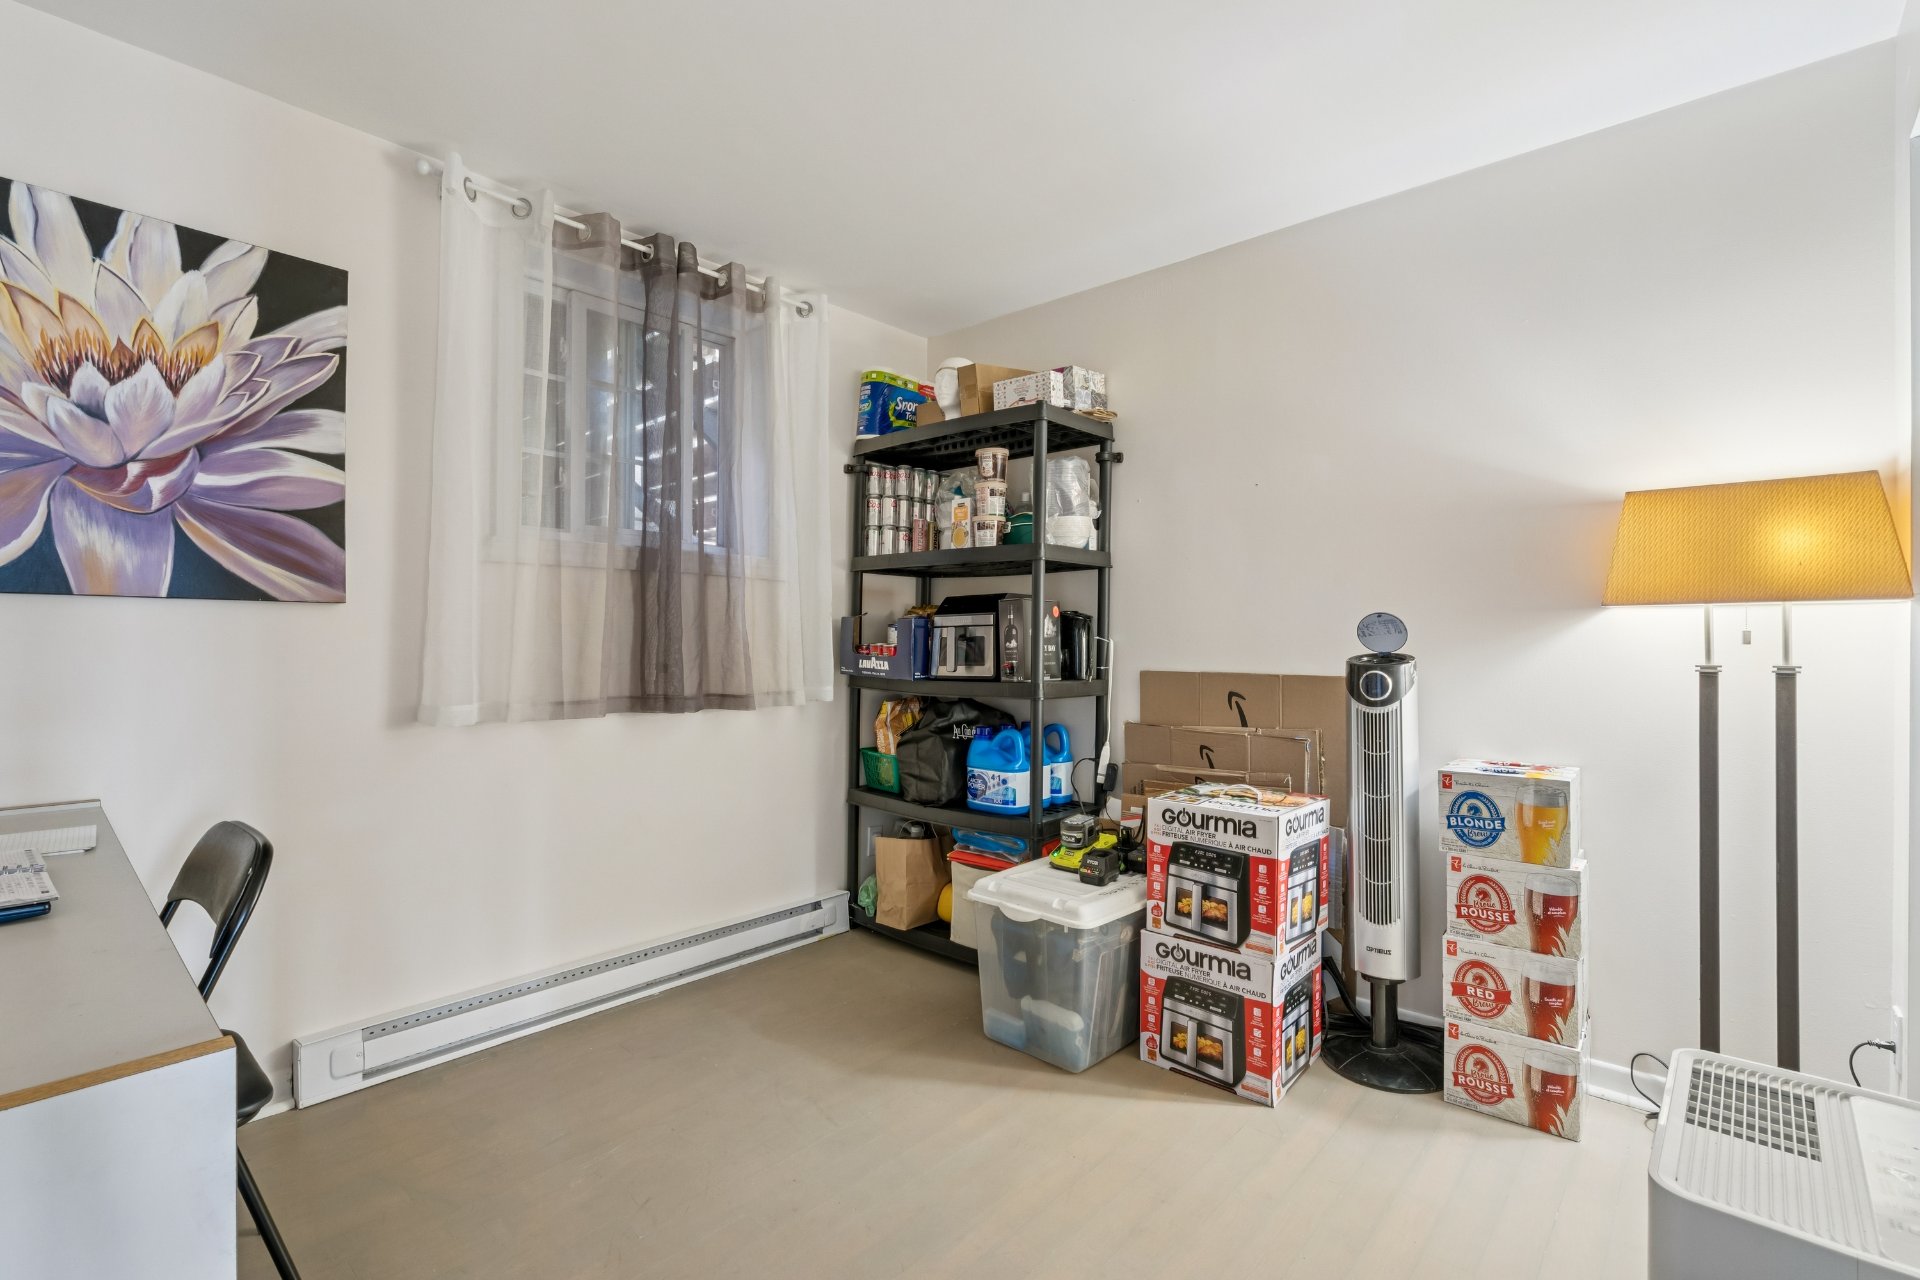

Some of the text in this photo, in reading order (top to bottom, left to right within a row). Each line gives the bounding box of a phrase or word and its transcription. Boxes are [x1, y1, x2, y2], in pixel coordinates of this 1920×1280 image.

[858, 656, 890, 671] LAVAZZA
[1449, 816, 1503, 829] BLONDE
[1162, 824, 1184, 834] DIGITAL
[1196, 830, 1217, 840] FRYER
[1162, 830, 1189, 841] FRITEUSE
[1247, 845, 1272, 856] CHAUD
[1460, 906, 1511, 922] ROUSSE
[1155, 958, 1179, 969] DIGITAL
[1179, 964, 1191, 972] AIR
[1191, 968, 1211, 978] FRYER
[1156, 963, 1184, 977] FRITEUSE
[1229, 984, 1241, 993] AIR
[1241, 987, 1267, 999] CHAUD
[1466, 985, 1496, 1000] RED
[1457, 1074, 1508, 1095] ROUSSE
